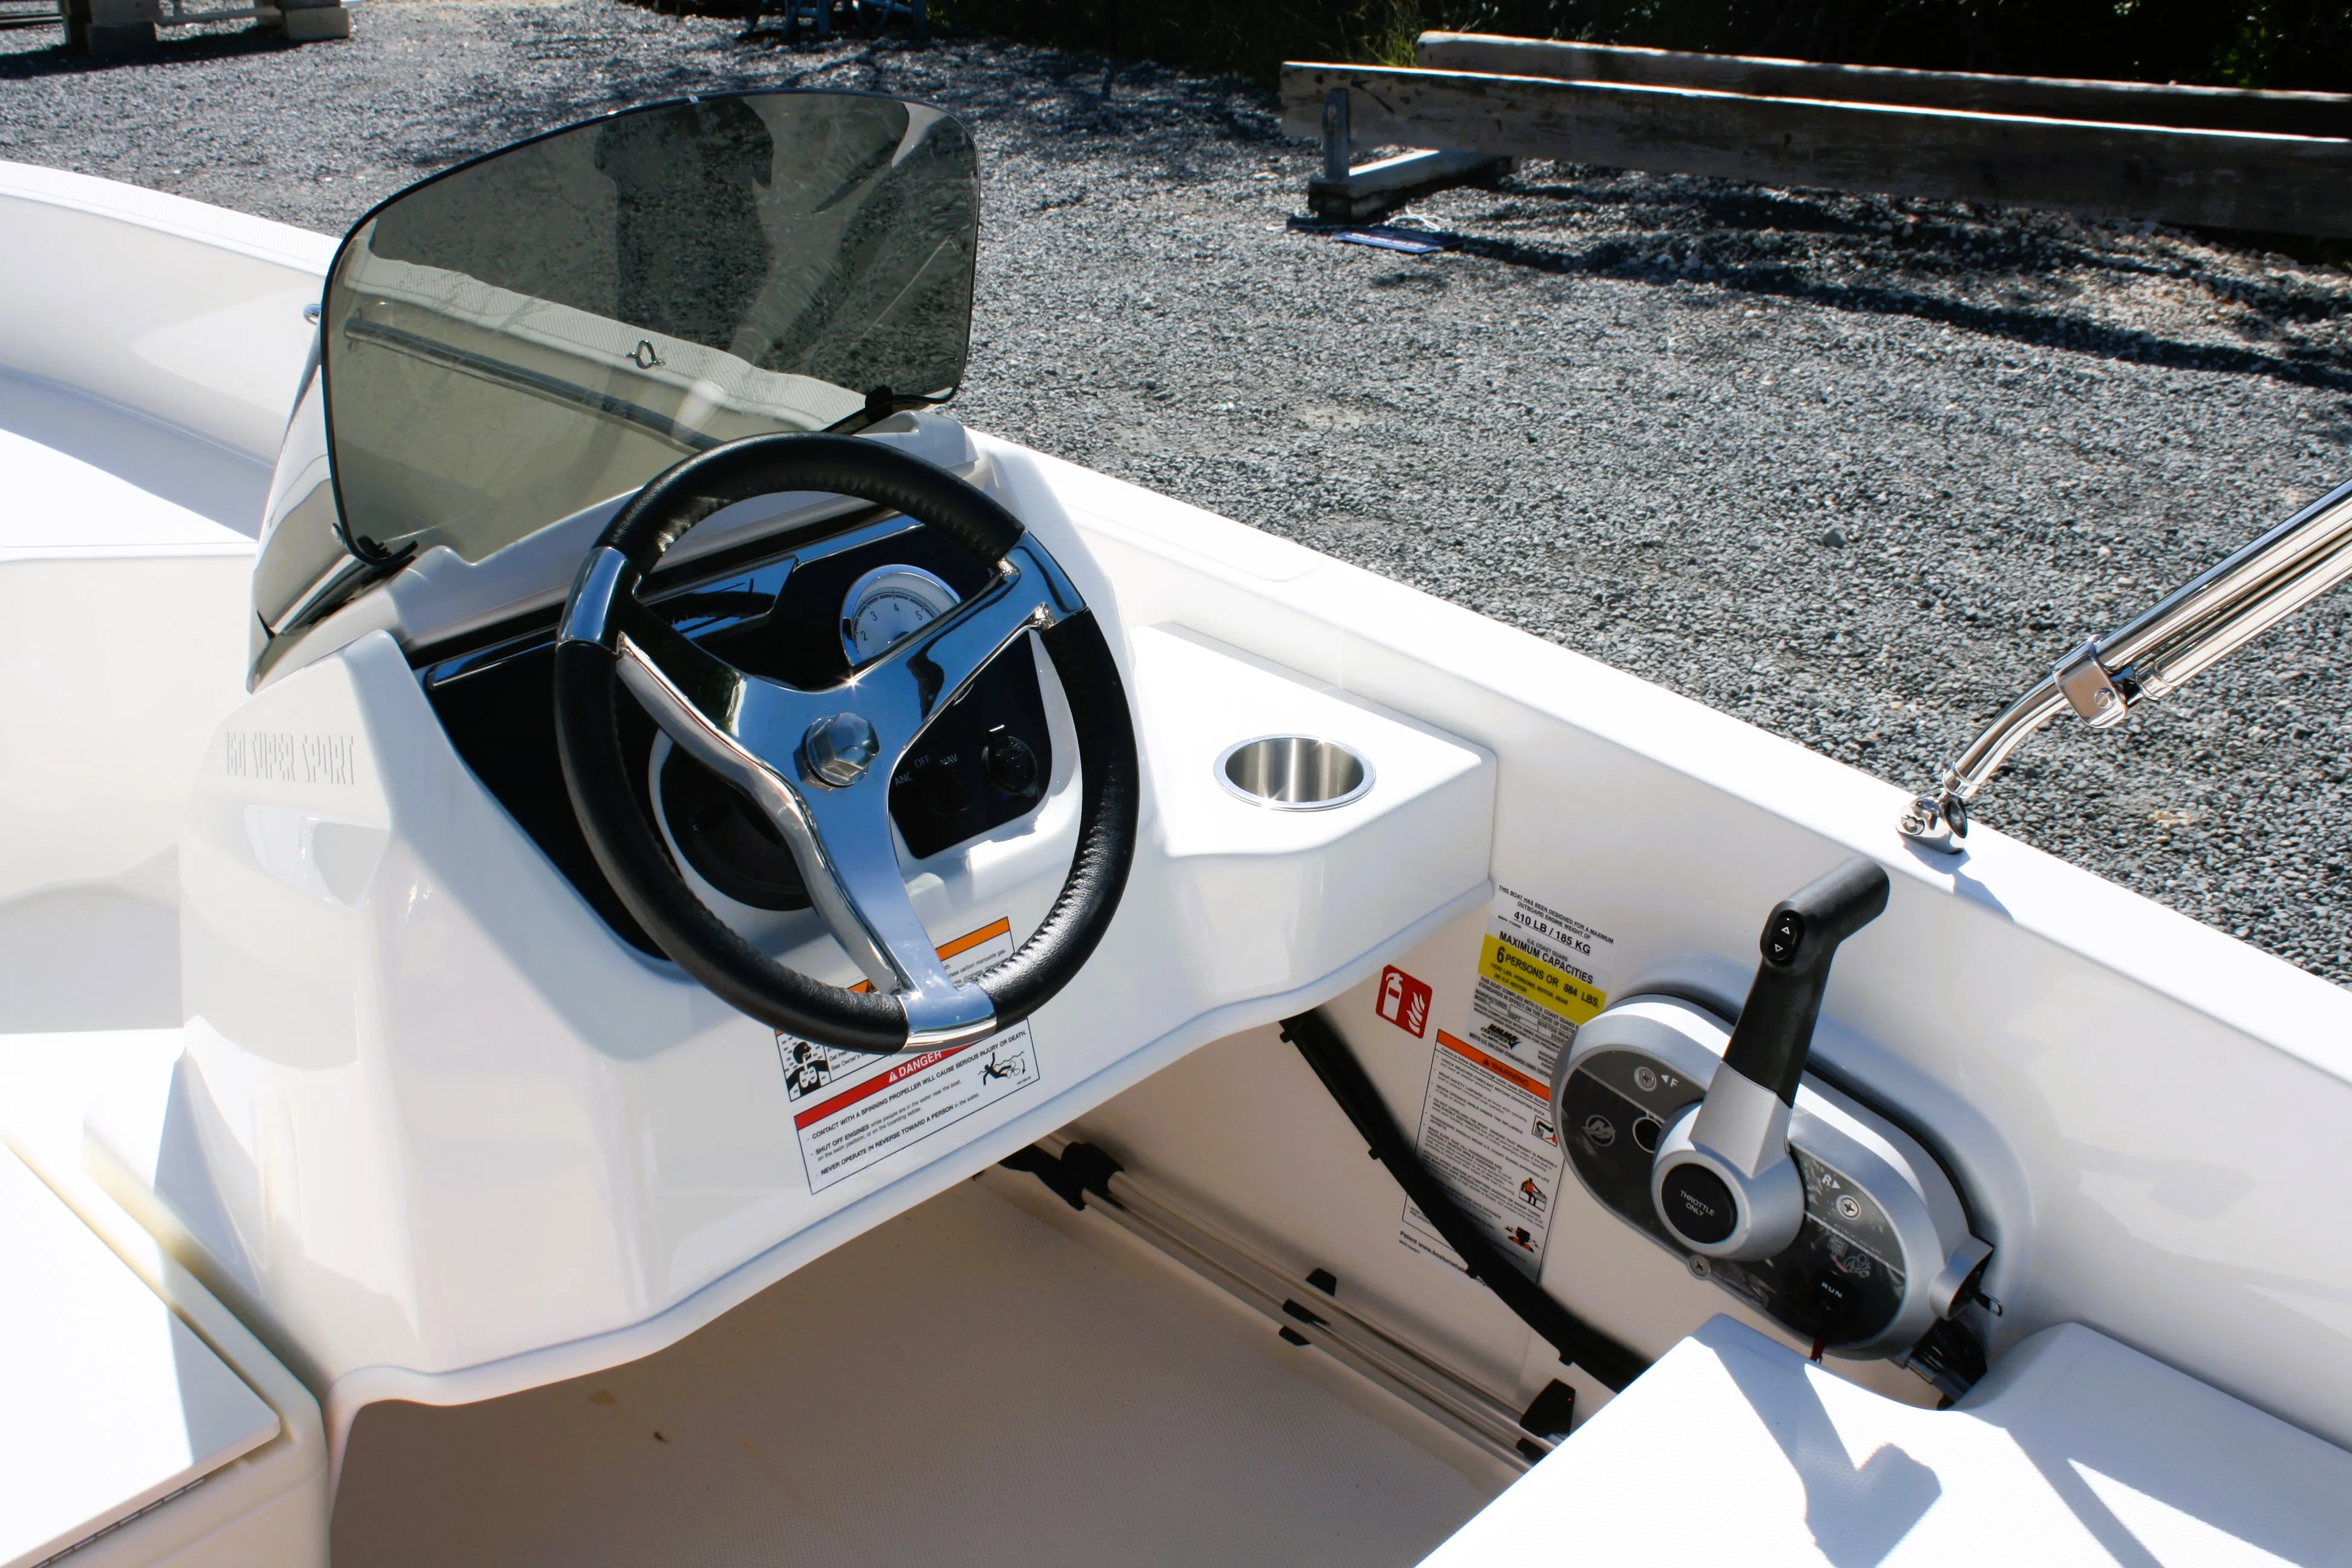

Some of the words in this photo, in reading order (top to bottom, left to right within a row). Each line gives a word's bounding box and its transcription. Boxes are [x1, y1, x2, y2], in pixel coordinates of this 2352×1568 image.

[870, 611, 877, 621] 3
[893, 604, 900, 612] 4
[916, 610, 923, 621] 5
[861, 630, 868, 641] 2
[252, 733, 295, 781] SUPER
[302, 734, 354, 785] SPORT
[914, 755, 930, 768] OFF
[939, 754, 958, 765] NAV
[895, 772, 913, 786] ANC
[1498, 885, 1509, 893] THIS
[1509, 890, 1523, 901] BOAT
[1523, 897, 1534, 906] HAS
[1534, 902, 1547, 912] BEEN
[1548, 909, 1573, 924] DESIGNED
[1573, 921, 1584, 930] FOR
[1589, 928, 1613, 944] MAXIMUM
[1517, 901, 1544, 918] OUTBOARD
[1544, 914, 1563, 927] ENGINE
[1563, 923, 1583, 936] WEIGHT
[1513, 910, 1531, 926] 410
[1533, 919, 1547, 933] LB
[1555, 930, 1573, 946] 185
[1575, 939, 1591, 954] KG
[1498, 930, 1540, 958] MAXIMUM
[1541, 952, 1593, 984] CAPACITIES
[1535, 942, 1551, 953] COAST
[1552, 950, 1568, 961] GUARD
[1495, 944, 1506, 964] 6
[1505, 953, 1544, 979] PERSONS
[1545, 973, 1559, 987] OR
[1581, 990, 1601, 1007] LBS.
[898, 1050, 942, 1078] DANGER
[811, 1122, 839, 1140] CONTACT
[840, 1114, 855, 1126] WITH
[861, 1097, 888, 1116] SPINNING
[888, 1080, 921, 1102] PROPELLER
[922, 1074, 935, 1085] WILL
[935, 1064, 955, 1079] CAUSE
[955, 1052, 979, 1069] SERIOUS
[979, 1042, 998, 1057] INJURY
[999, 1038, 1007, 1047] OR
[1007, 1028, 1026, 1042] DEATH.
[1491, 1062, 1530, 1087] WARNING
[1670, 1078, 1678, 1087] F
[815, 1142, 831, 1155] SHUT
[832, 1136, 843, 1146] OFF
[844, 1123, 869, 1140] ENGINES
[820, 1161, 840, 1175] NEVER
[841, 1148, 867, 1165] OPERATE
[875, 1131, 900, 1148] REVERSE
[901, 1118, 926, 1135] TOWARD
[931, 1103, 954, 1120] PERSON
[1822, 1174, 1832, 1186] R
[1681, 1190, 1715, 1217] THROTTLE
[1686, 1203, 1704, 1217] ONLY
[1856, 1237, 1883, 1256] LANYARD
[1821, 1282, 1843, 1298] RUN
